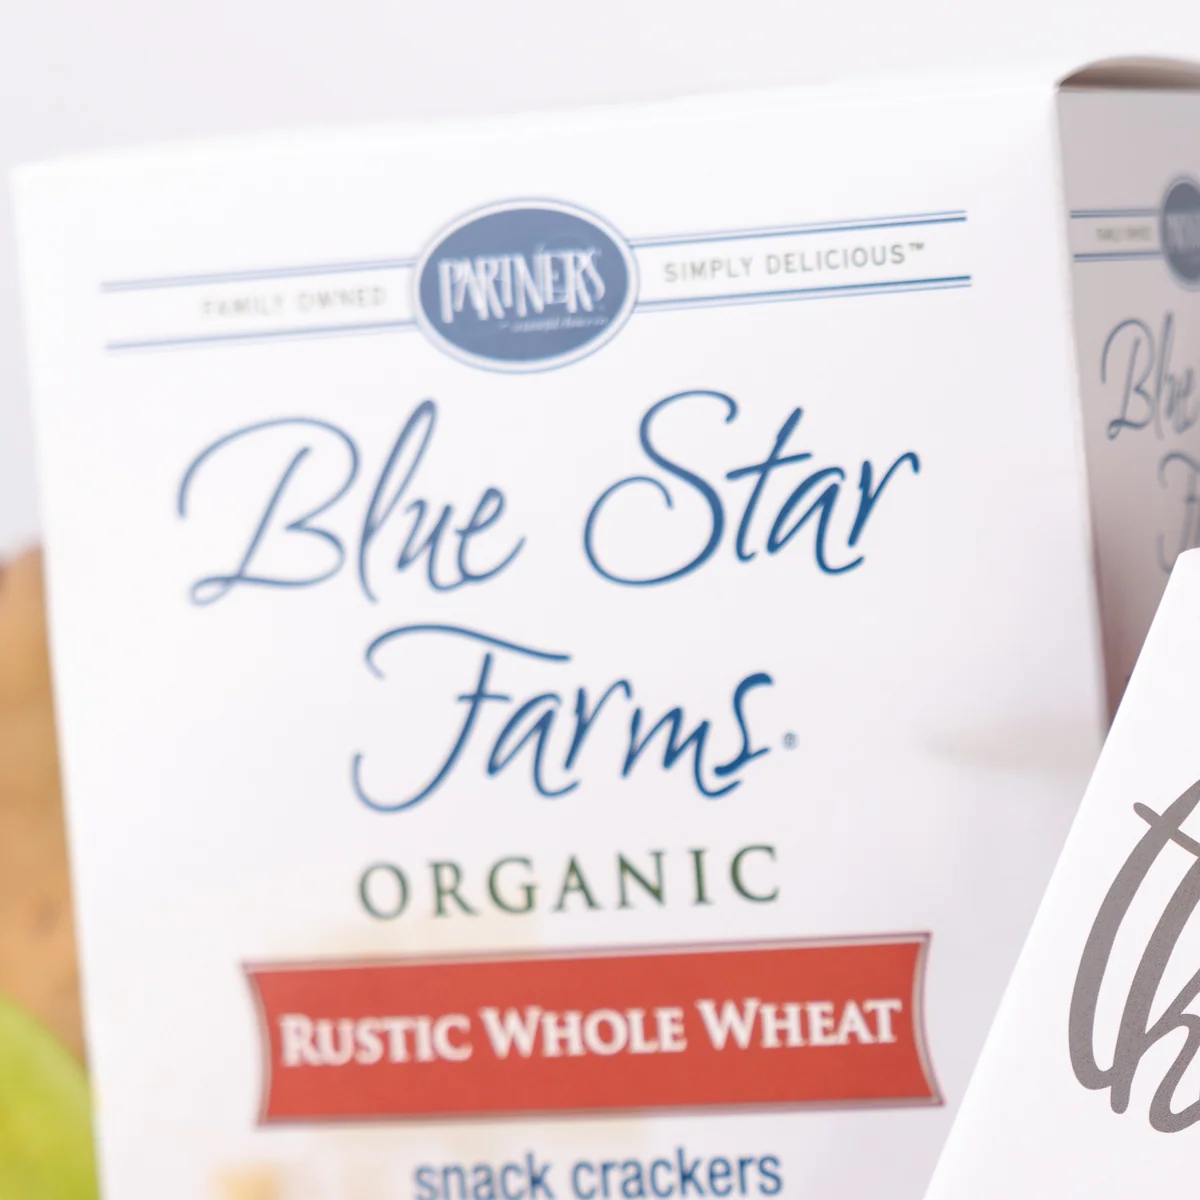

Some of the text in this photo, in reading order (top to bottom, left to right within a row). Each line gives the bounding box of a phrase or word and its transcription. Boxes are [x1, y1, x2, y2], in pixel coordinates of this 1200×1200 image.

[663, 256, 753, 284] SIMPLY
[177, 398, 527, 606] Blue
[583, 388, 920, 587] Star
[356, 842, 783, 922] ORGANIC
